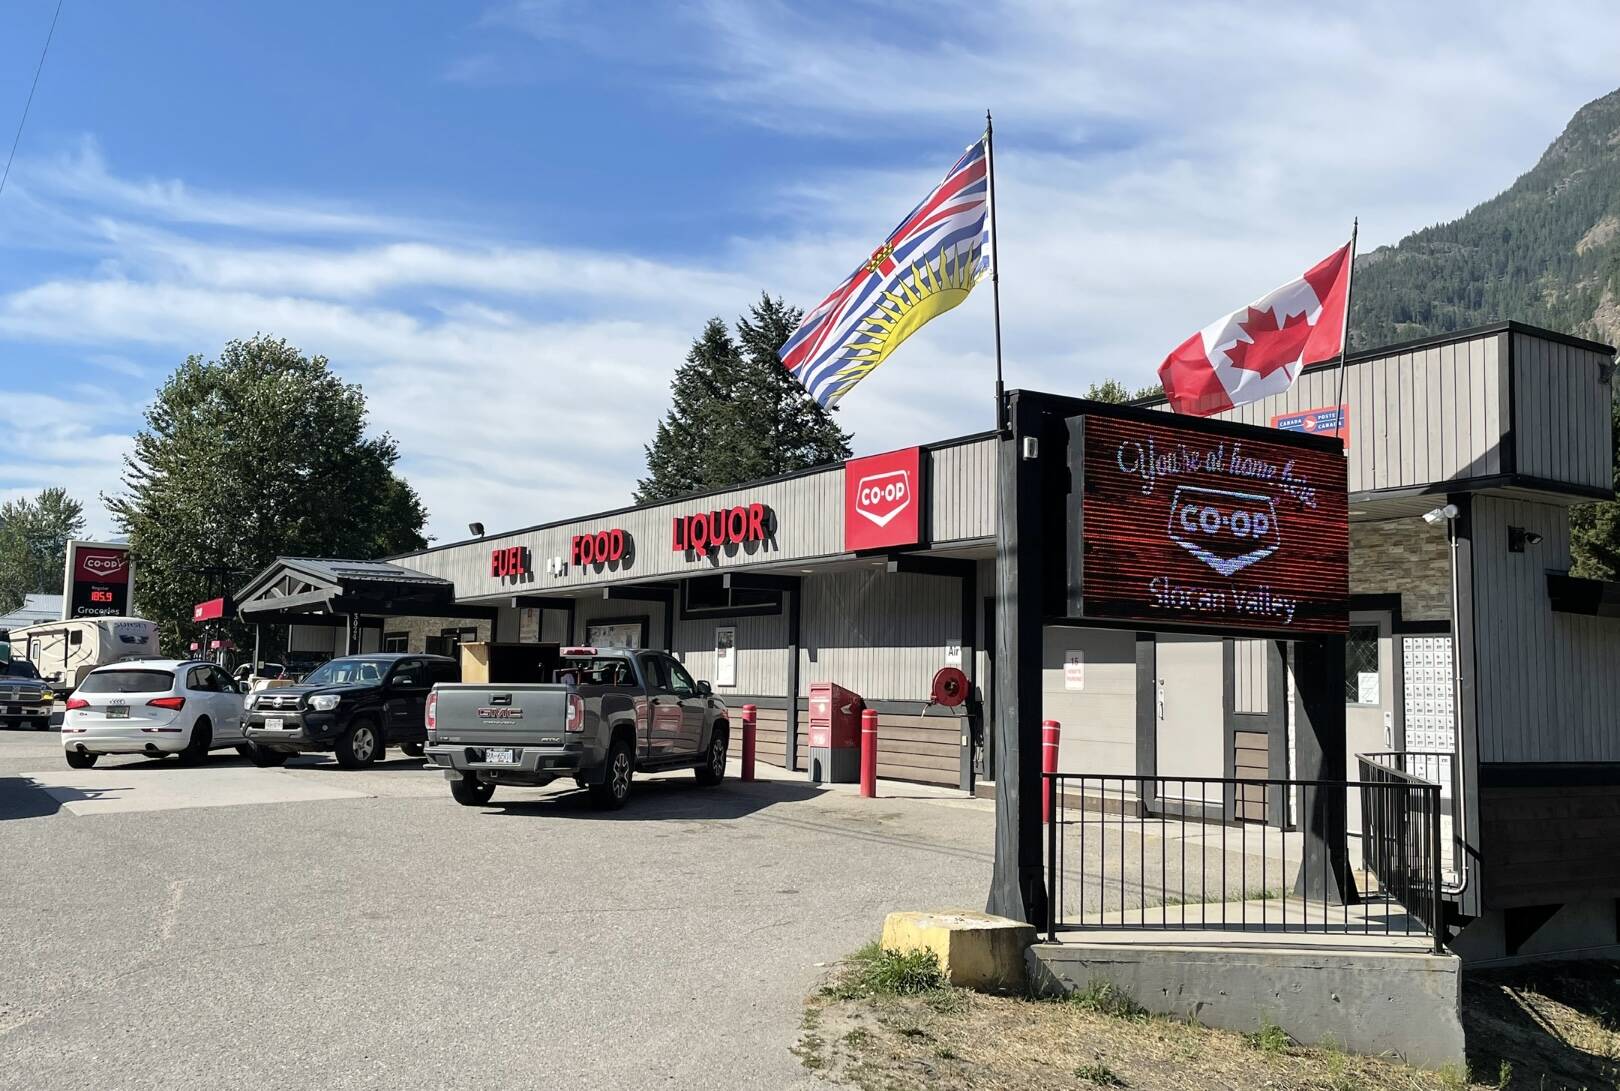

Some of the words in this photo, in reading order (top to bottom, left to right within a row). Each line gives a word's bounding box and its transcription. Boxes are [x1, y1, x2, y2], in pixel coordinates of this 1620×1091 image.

[1280, 418, 1302, 427] CANADA
[672, 502, 765, 557] LIQUOR
[571, 529, 624, 567] FOOD
[491, 546, 525, 578] FUEL
[77, 606, 120, 615] Groceries
[948, 646, 959, 656] Air
[478, 707, 523, 719] GMC
